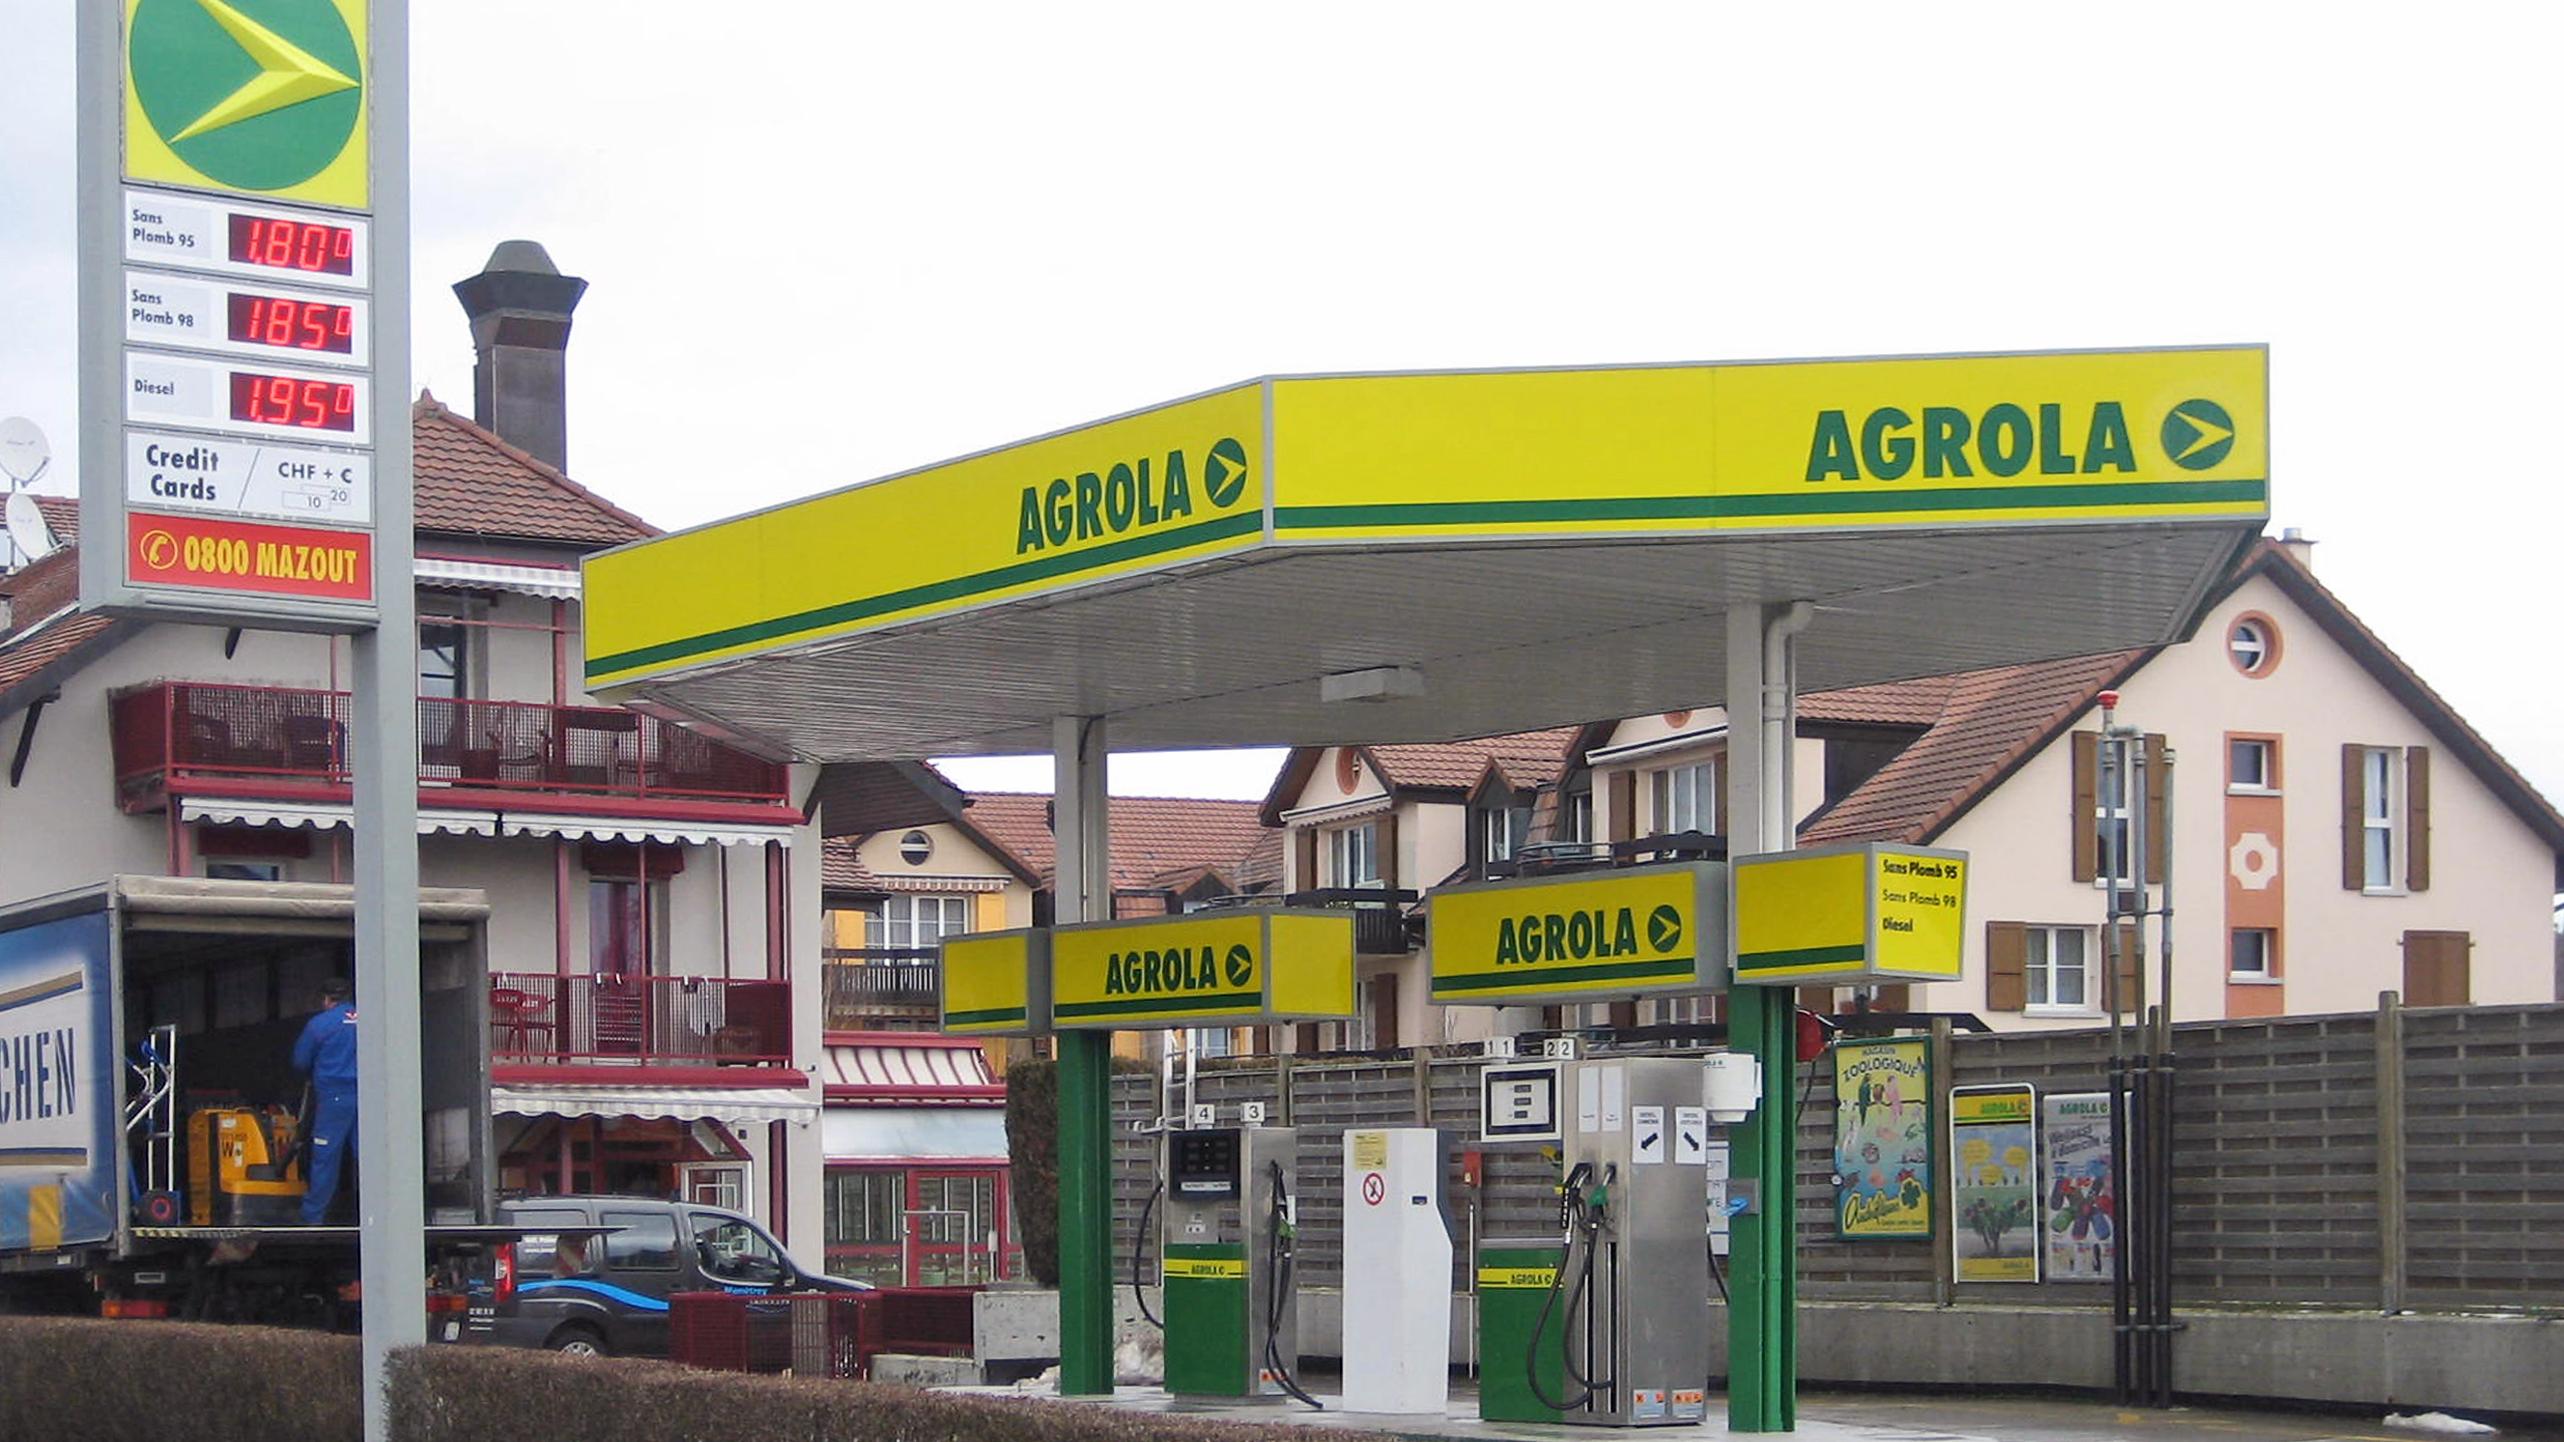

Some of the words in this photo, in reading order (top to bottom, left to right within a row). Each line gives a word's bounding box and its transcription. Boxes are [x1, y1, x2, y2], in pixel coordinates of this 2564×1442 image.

[132, 209, 163, 225] Sans
[132, 228, 175, 246] Plomb
[179, 234, 195, 248] 95
[131, 289, 162, 305] Sans
[131, 308, 174, 326] Plomb
[177, 313, 195, 328] 98
[134, 379, 175, 396] Diesel
[1804, 401, 2137, 482] AGROLA
[146, 444, 219, 472] Credit
[278, 461, 316, 480] CHF
[151, 473, 216, 501] Cards
[308, 495, 322, 509] 10
[331, 489, 348, 503] 20
[1016, 449, 1193, 555] AGROLA
[183, 535, 250, 577] 0800
[254, 542, 359, 585] MAZOUT
[1883, 859, 1907, 874] Sans
[1909, 861, 1943, 878] Plomb
[1944, 865, 1958, 880] 95
[1883, 889, 1907, 904] Sans
[1909, 891, 1941, 906] Plomb
[1943, 895, 1957, 908] 98
[1882, 917, 1914, 933] Diesel
[1496, 907, 1638, 965] AGROLA
[1105, 946, 1217, 995] AGROLA
[1842, 1057, 1919, 1082] ZOOLOGIQUE
[1199, 1107, 1210, 1120] 4
[1249, 1105, 1260, 1118] 3
[1510, 1274, 1544, 1285] AGROLA
